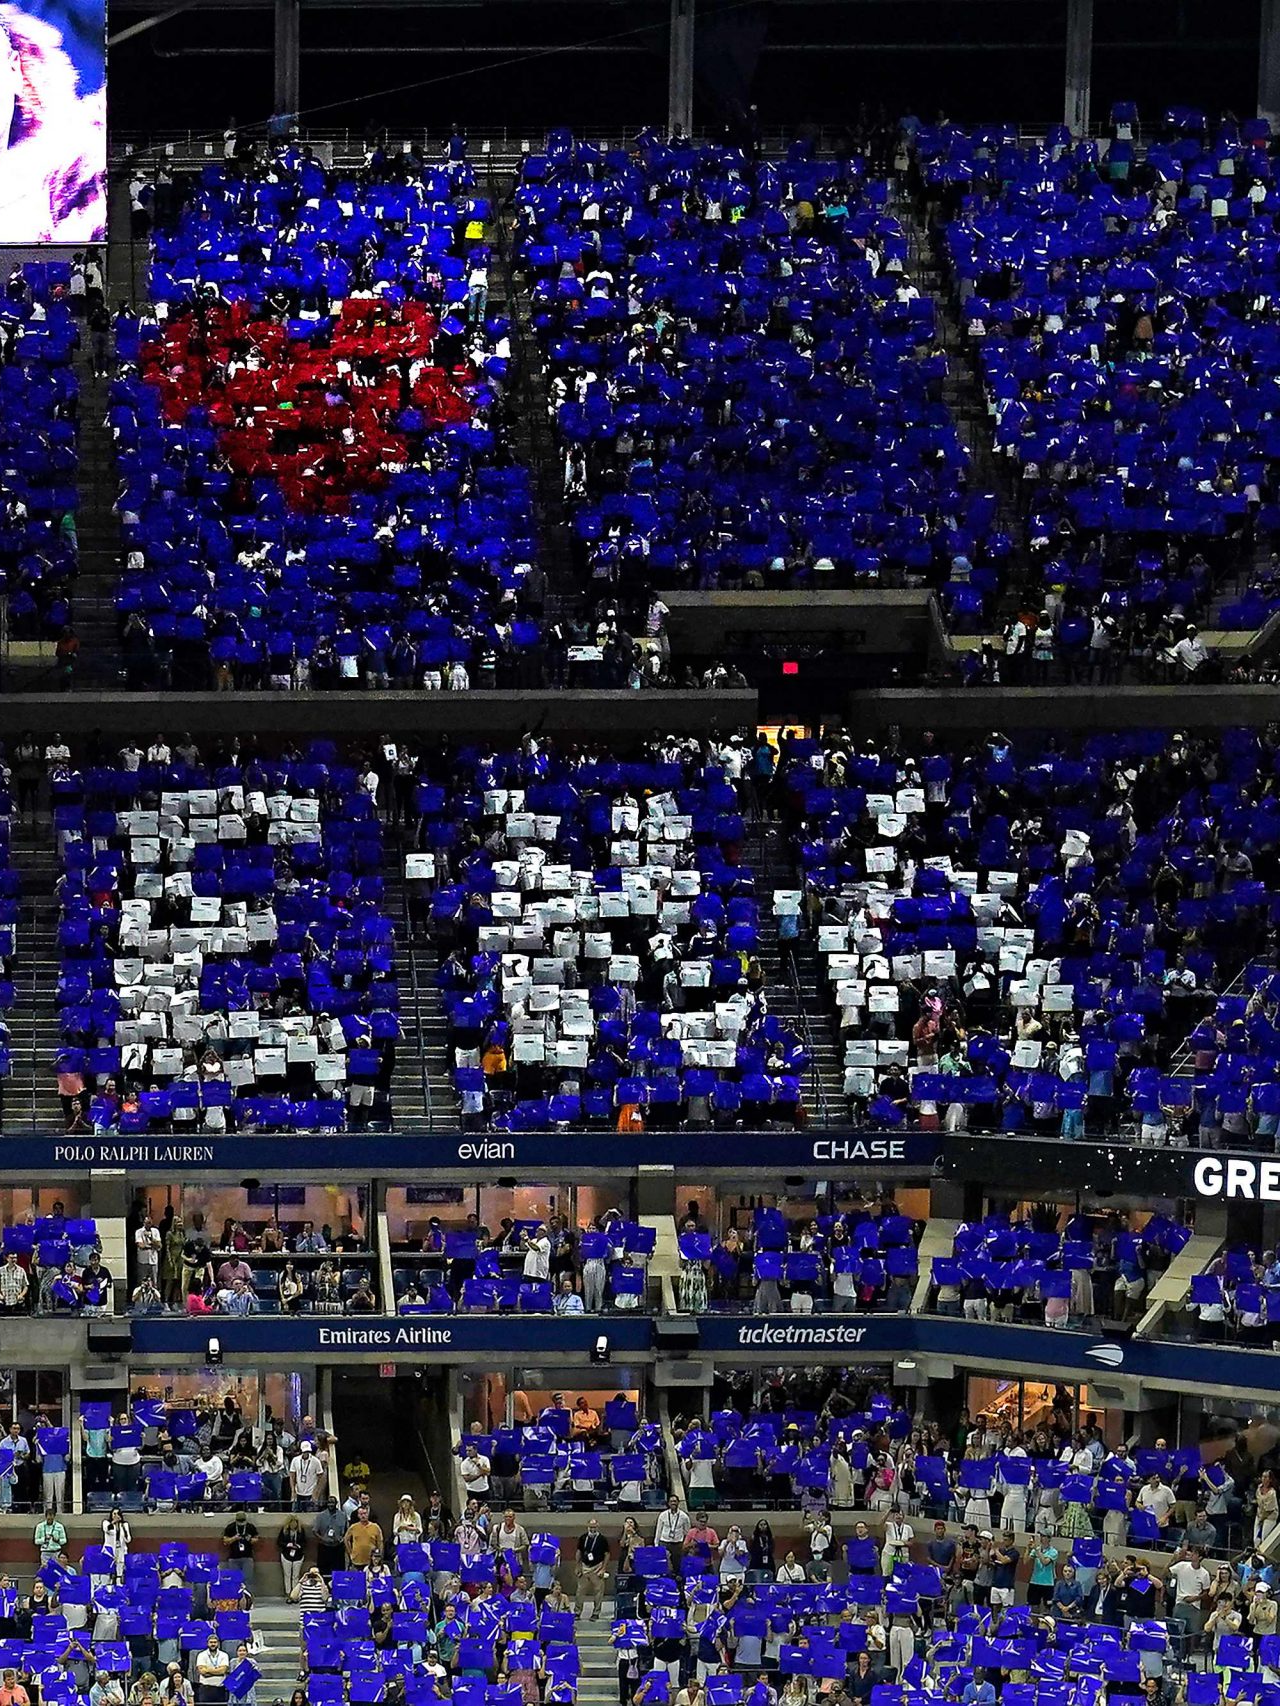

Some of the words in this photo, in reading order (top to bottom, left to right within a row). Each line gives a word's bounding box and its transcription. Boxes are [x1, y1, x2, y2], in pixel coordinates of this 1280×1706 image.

[54, 1146, 95, 1161] POLO
[99, 1146, 149, 1161] RALPH
[154, 1146, 214, 1161] LAUREN
[458, 1138, 515, 1160] evian
[813, 1140, 906, 1159] CHASE
[319, 1327, 391, 1344] Emirates
[395, 1327, 451, 1344] Airline
[738, 1323, 867, 1343] ticketmaster
